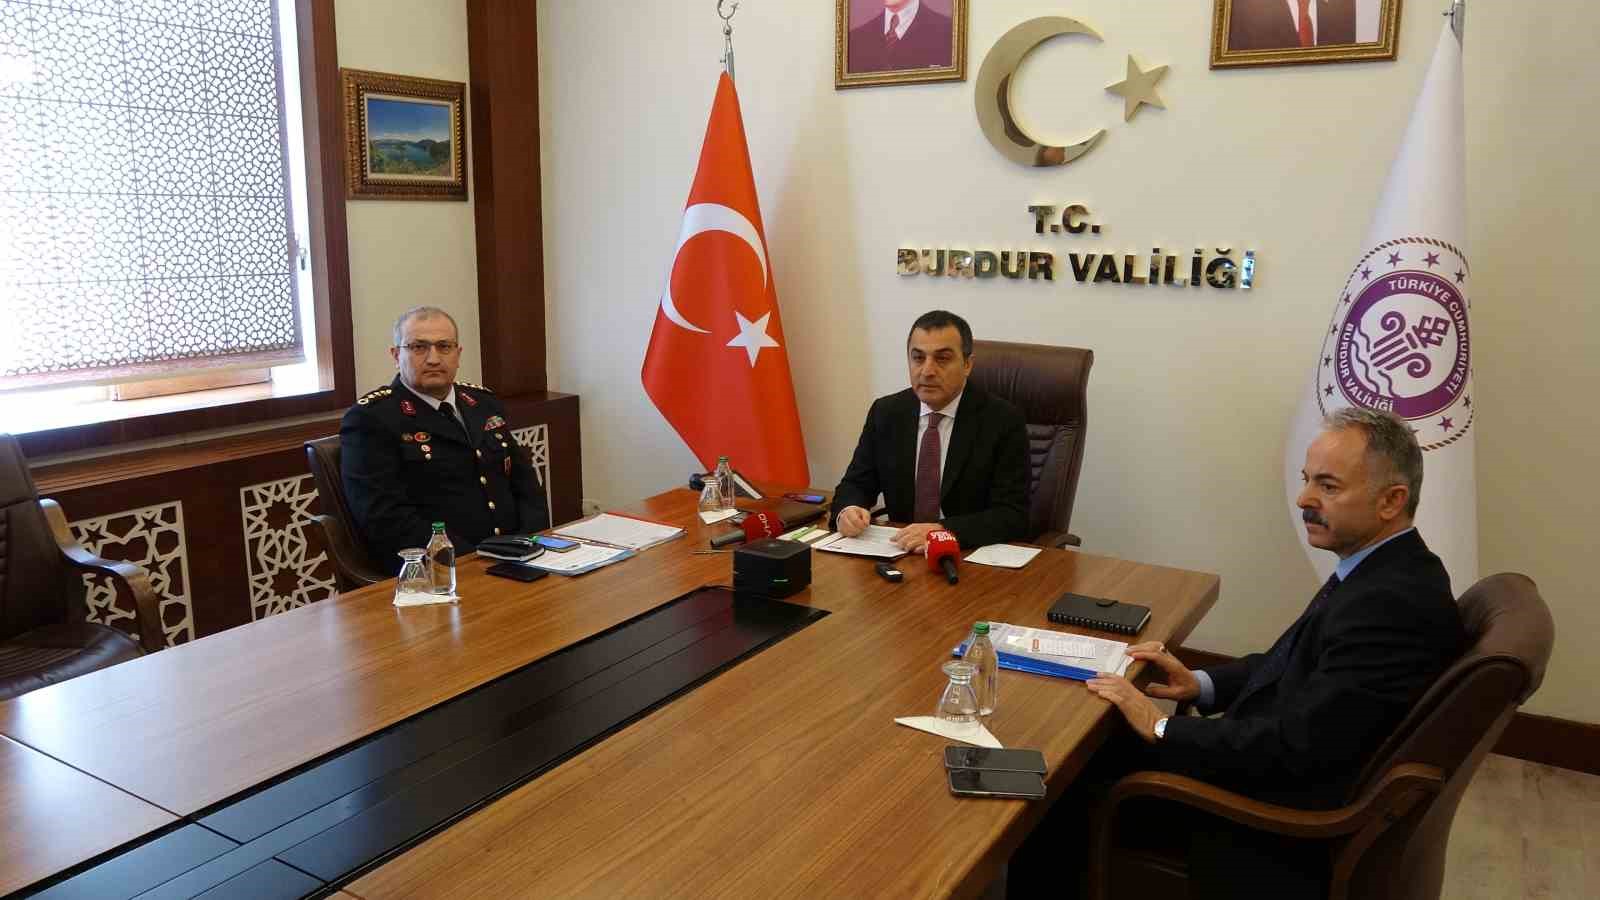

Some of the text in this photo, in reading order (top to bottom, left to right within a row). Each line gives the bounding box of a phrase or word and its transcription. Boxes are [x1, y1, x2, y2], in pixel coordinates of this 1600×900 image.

[1028, 204, 1100, 234] T.C.
[897, 247, 1256, 289] BURDUR VALİLİĞİ
[1388, 276, 1452, 303] TÜRKİYE
[1339, 322, 1393, 412] BURDUR VALİLİĞİ
